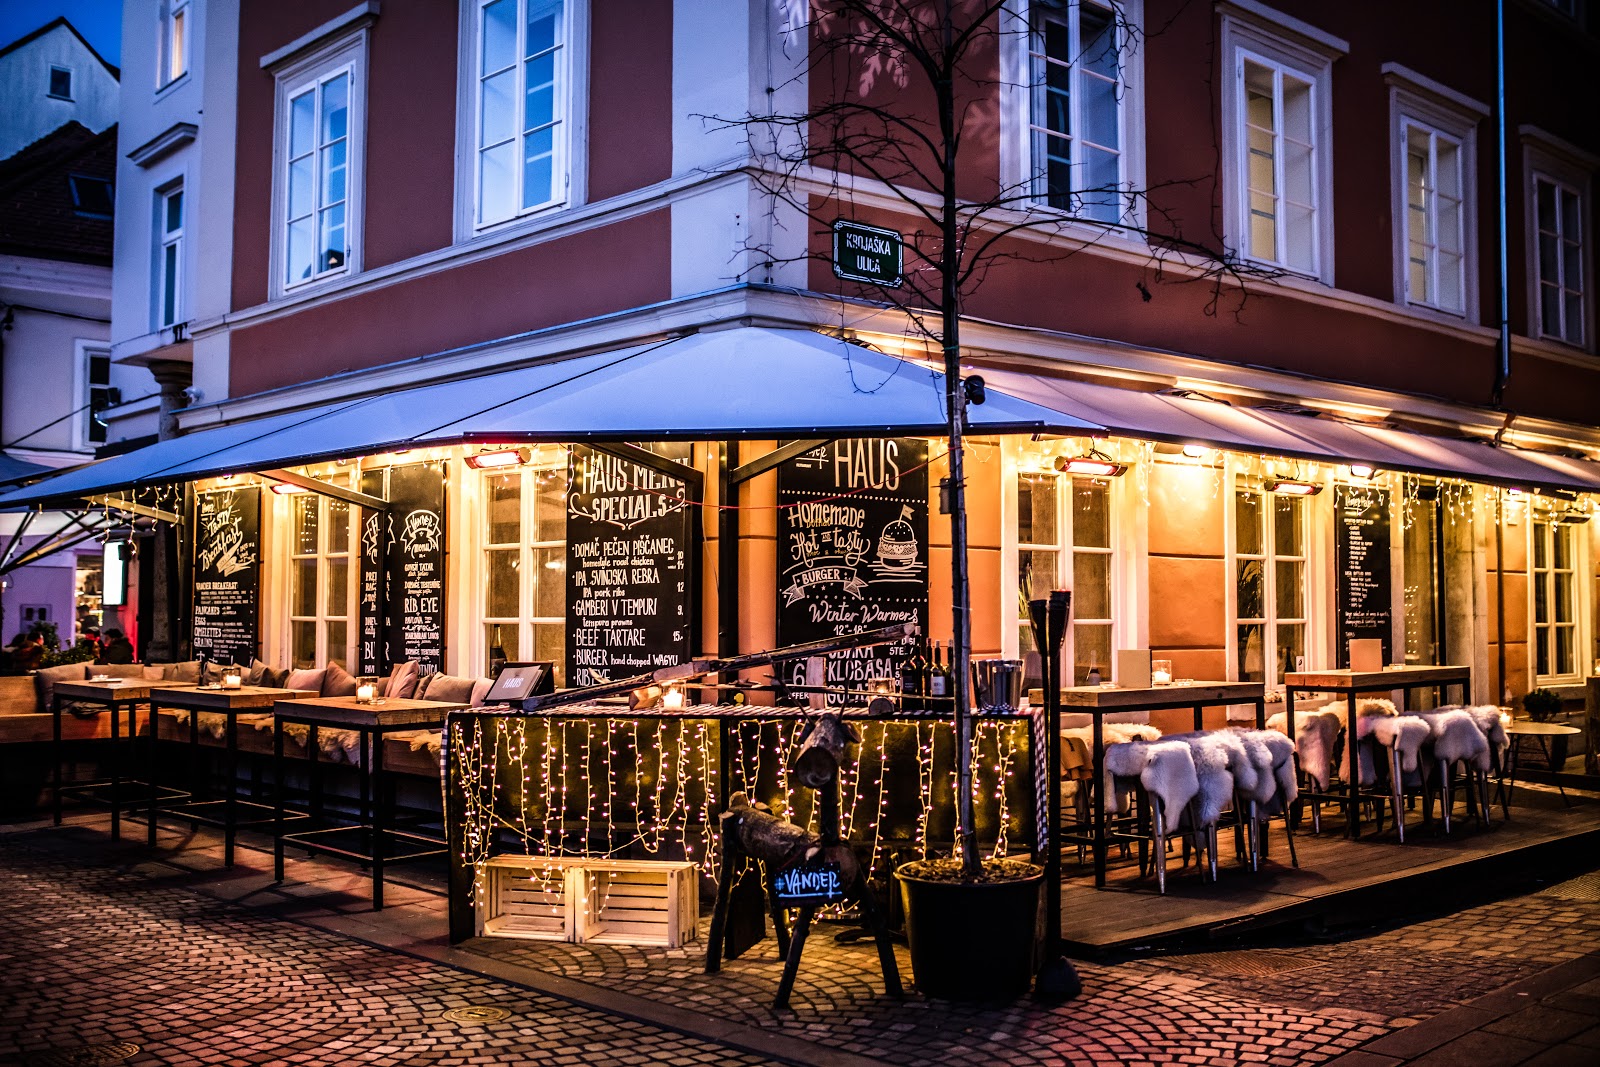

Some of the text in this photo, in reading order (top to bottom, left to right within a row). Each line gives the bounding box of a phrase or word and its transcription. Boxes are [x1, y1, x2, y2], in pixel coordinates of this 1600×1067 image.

[846, 233, 892, 256] KROJAŠKA
[857, 255, 881, 274] ULICA
[583, 454, 628, 495] HAUS
[835, 439, 900, 491] HAUS
[788, 501, 866, 529] Homemade
[574, 535, 675, 558] DOMAČ PEČEN PIŠČANEC
[790, 529, 820, 568] Hot
[832, 527, 871, 567] tasty
[630, 556, 655, 566] chicken
[575, 570, 587, 587] IPA
[631, 568, 661, 585] REBRA
[801, 569, 840, 585] BURGER
[583, 586, 626, 599] IPA pork ribs
[677, 582, 685, 593] 12
[420, 596, 439, 613] EYE
[575, 597, 658, 617] GAMBERI V TEMPURI
[808, 600, 919, 624] Winter Warmers
[576, 628, 601, 647] BEEF
[602, 628, 646, 647] TARTARE
[576, 649, 679, 667] BURGER hand chopped WAGYU
[889, 646, 908, 656] STE
[828, 657, 893, 682] KLOBASA
[502, 677, 524, 689] HAUS
[788, 692, 810, 700] FFER
